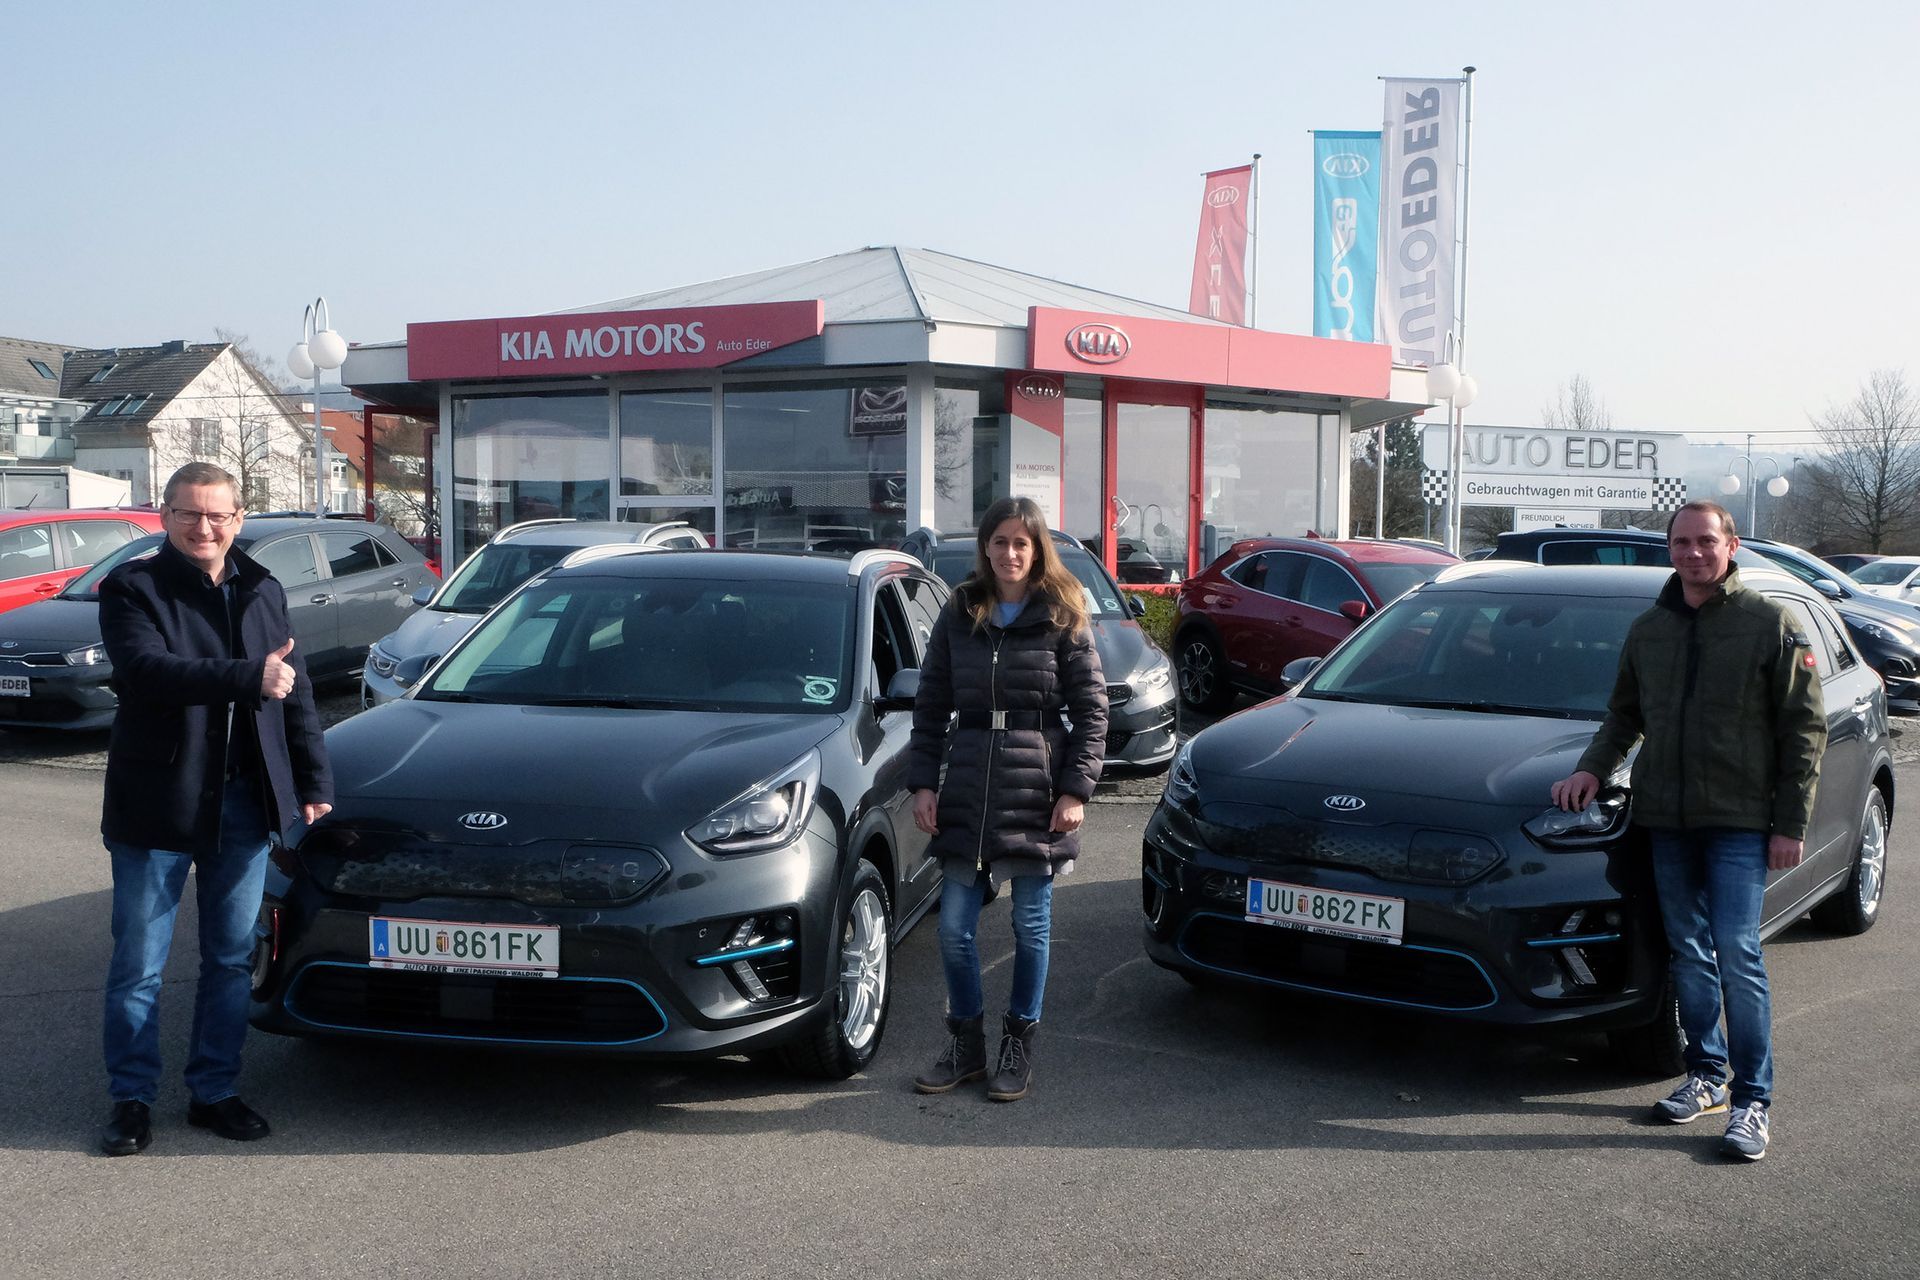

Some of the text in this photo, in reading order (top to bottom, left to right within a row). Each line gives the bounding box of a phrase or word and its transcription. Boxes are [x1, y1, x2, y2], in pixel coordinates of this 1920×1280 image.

[501, 321, 772, 361] KIA MOTORS Auto Eder
[1078, 331, 1121, 356] KIA
[1566, 436, 1658, 470] EDER
[1467, 481, 1647, 499] Gebrauchtwagen mit Garantie
[1521, 514, 1565, 522] FREUNDLICH
[1267, 888, 1293, 915] UU
[378, 943, 386, 952] A
[397, 926, 430, 956] UU
[404, 963, 426, 971] AUTO
[427, 965, 447, 973] EDER
